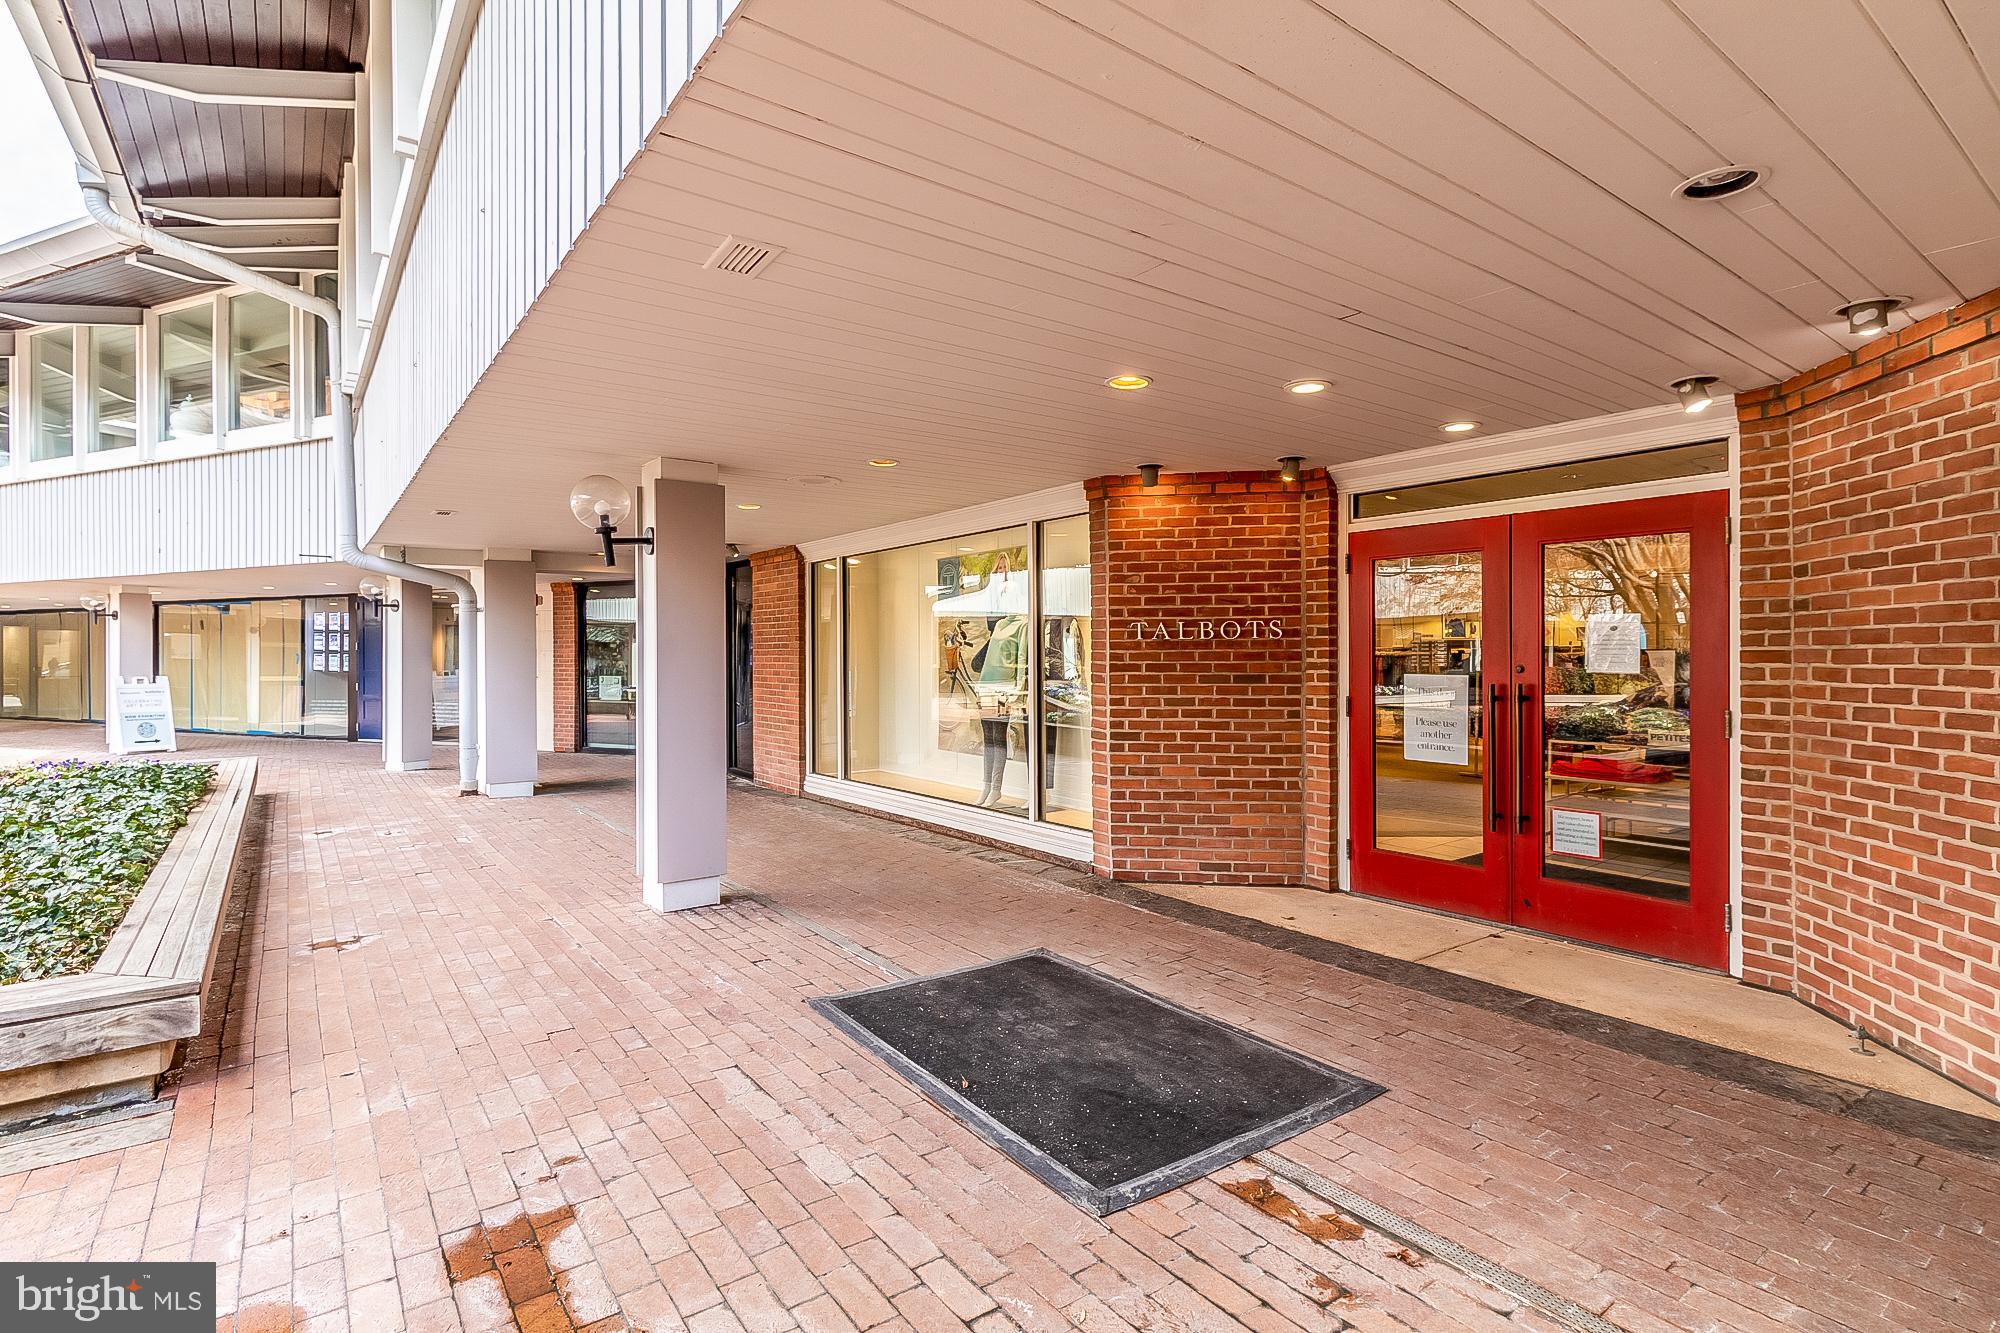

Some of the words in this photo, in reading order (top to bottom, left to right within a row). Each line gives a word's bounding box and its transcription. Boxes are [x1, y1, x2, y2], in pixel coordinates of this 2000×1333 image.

[1129, 619, 1283, 640] TALBOTS
[1415, 716, 1441, 728] Please
[1442, 720, 1458, 728] use
[1420, 730, 1453, 740] another
[1417, 741, 1456, 752] entrance.
